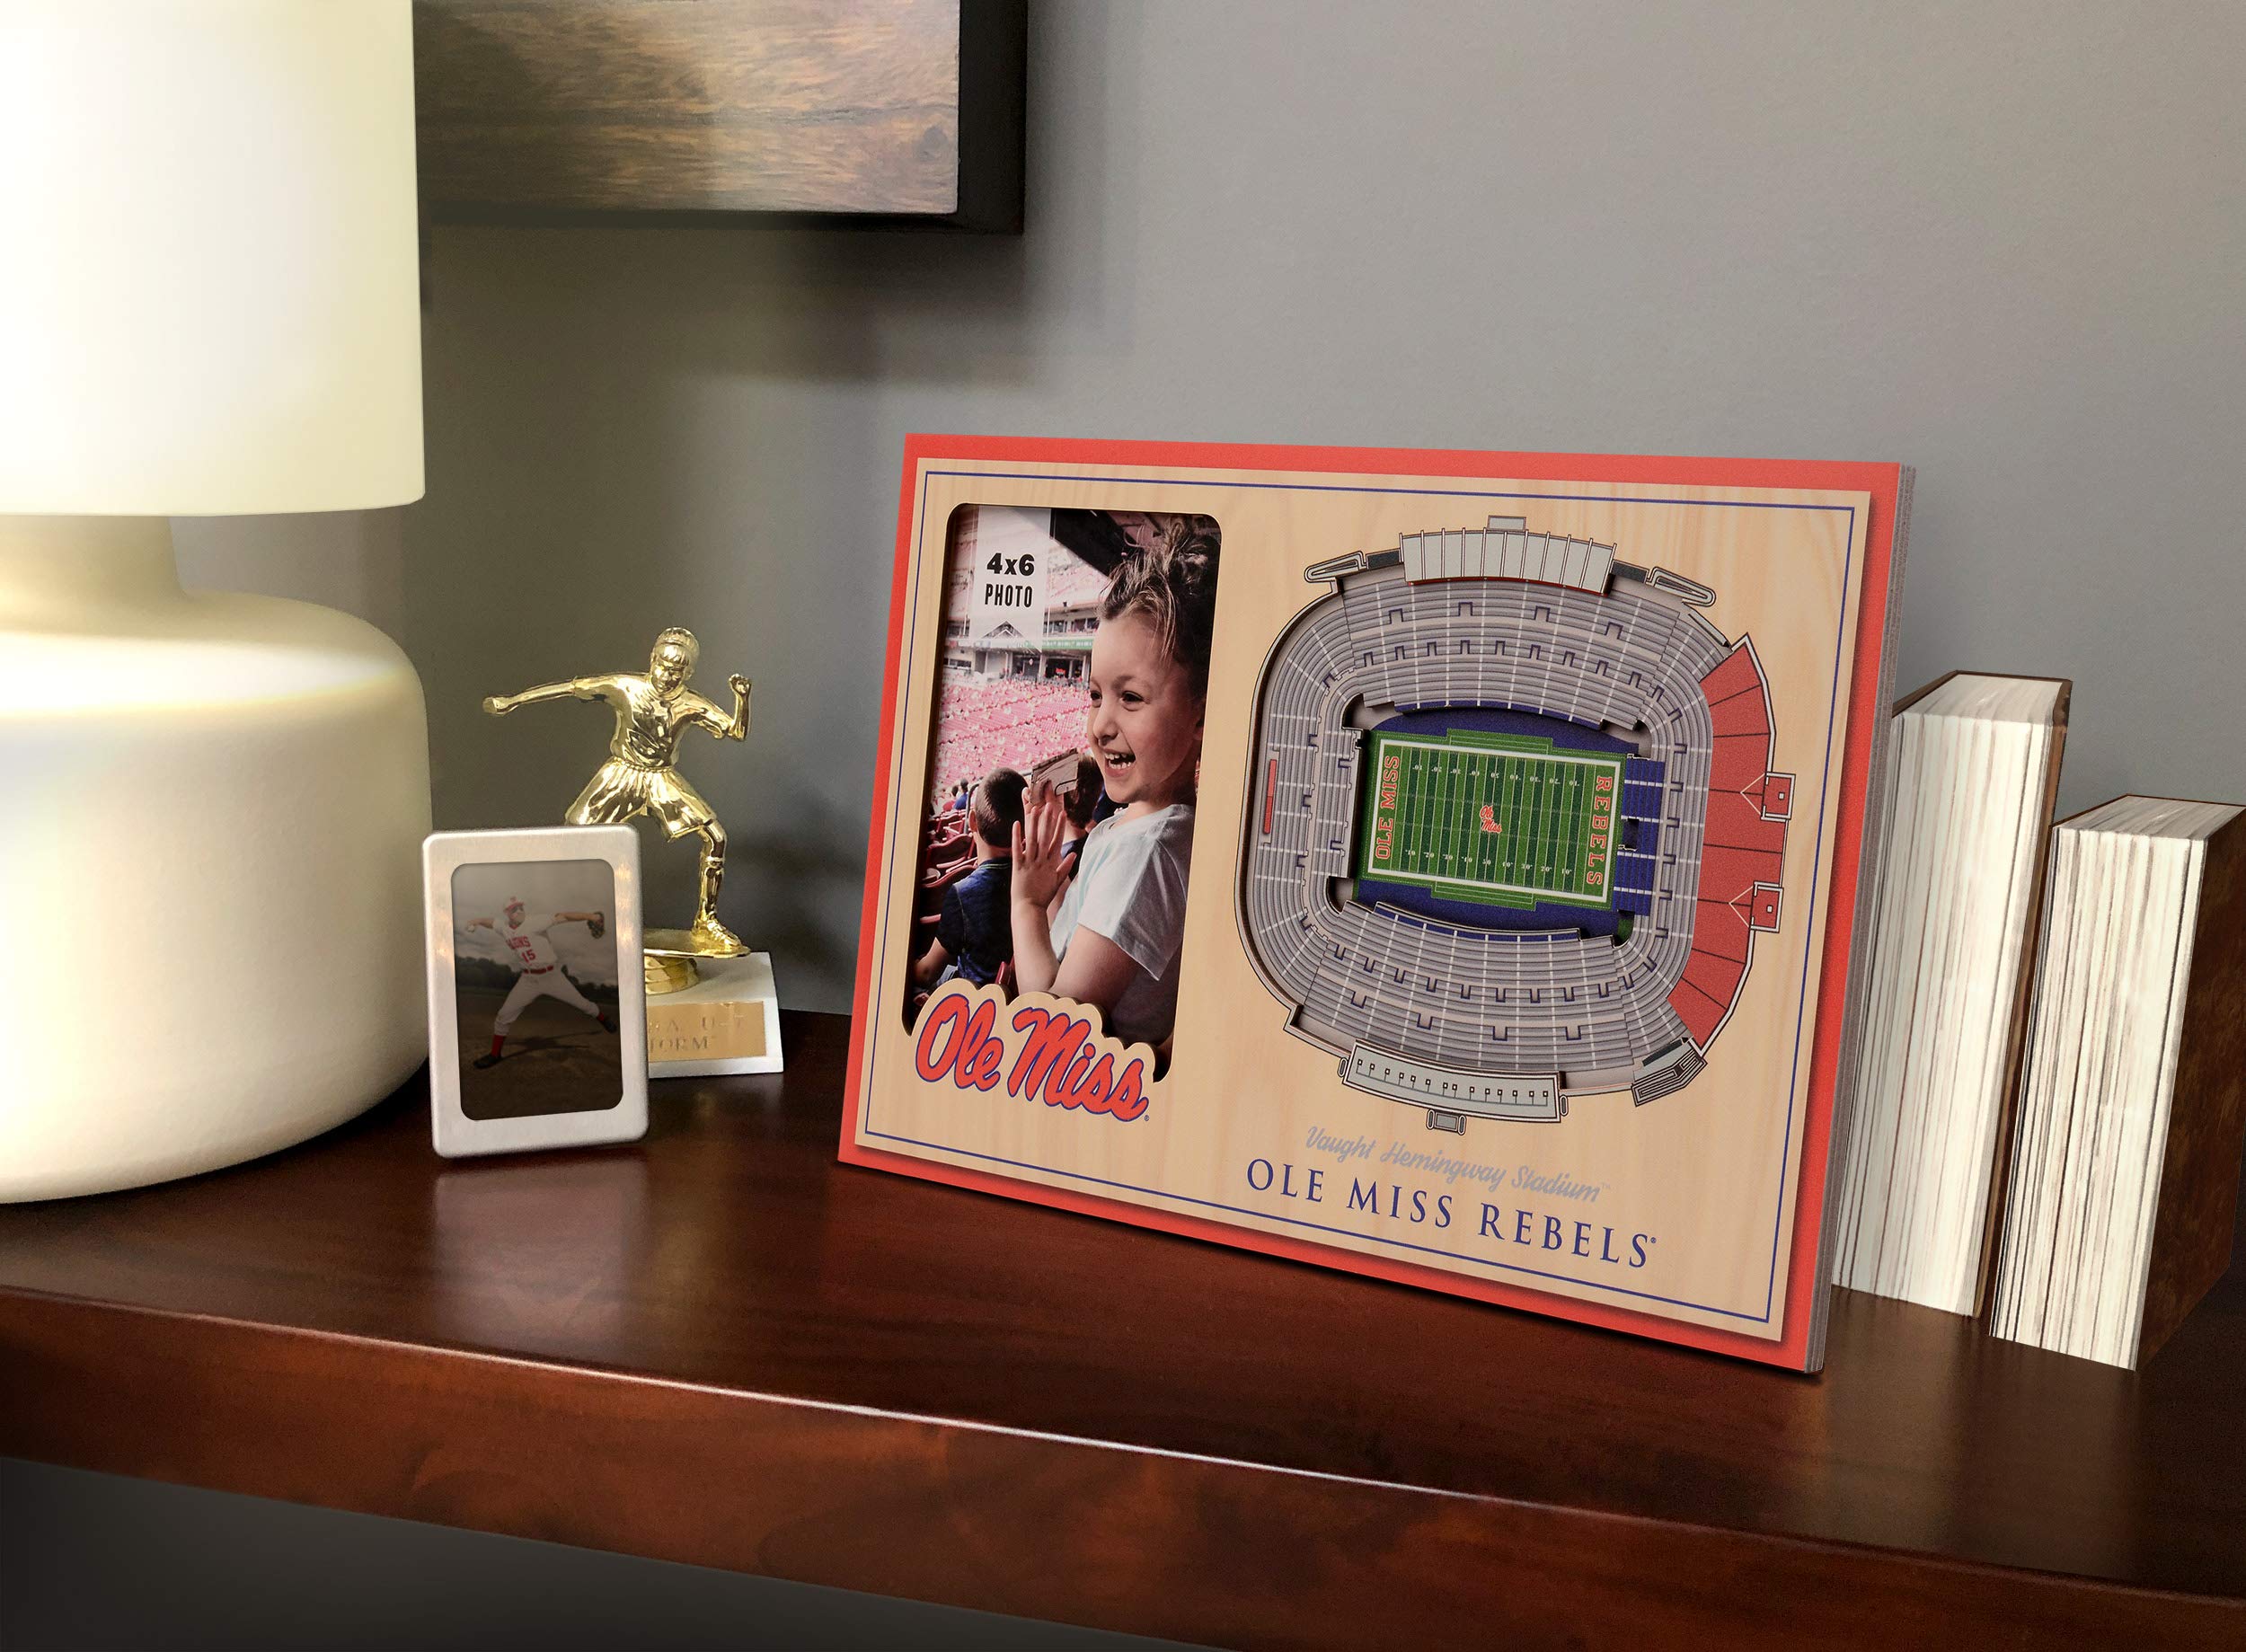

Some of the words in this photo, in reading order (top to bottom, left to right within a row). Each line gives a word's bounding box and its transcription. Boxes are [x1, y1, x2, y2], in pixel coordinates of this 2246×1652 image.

[986, 552, 1035, 576] 4x6
[985, 584, 1032, 608] PHOTO
[1380, 755, 1400, 809] MISS
[1479, 805, 1494, 818] Ole
[1481, 817, 1502, 834] Miss
[1587, 775, 1613, 885] REBELS
[1375, 817, 1393, 860] OLE
[522, 949, 536, 964] 15
[915, 994, 1004, 1091] Ole
[1007, 1007, 1149, 1122] Miss
[1306, 1126, 1376, 1163] Vaught
[1379, 1141, 1507, 1192] Hemingway
[1511, 1165, 1601, 1202] Stadium
[1247, 1158, 1324, 1203] OLE
[1347, 1177, 1453, 1229] MISS
[1477, 1202, 1649, 1268] REBELS
